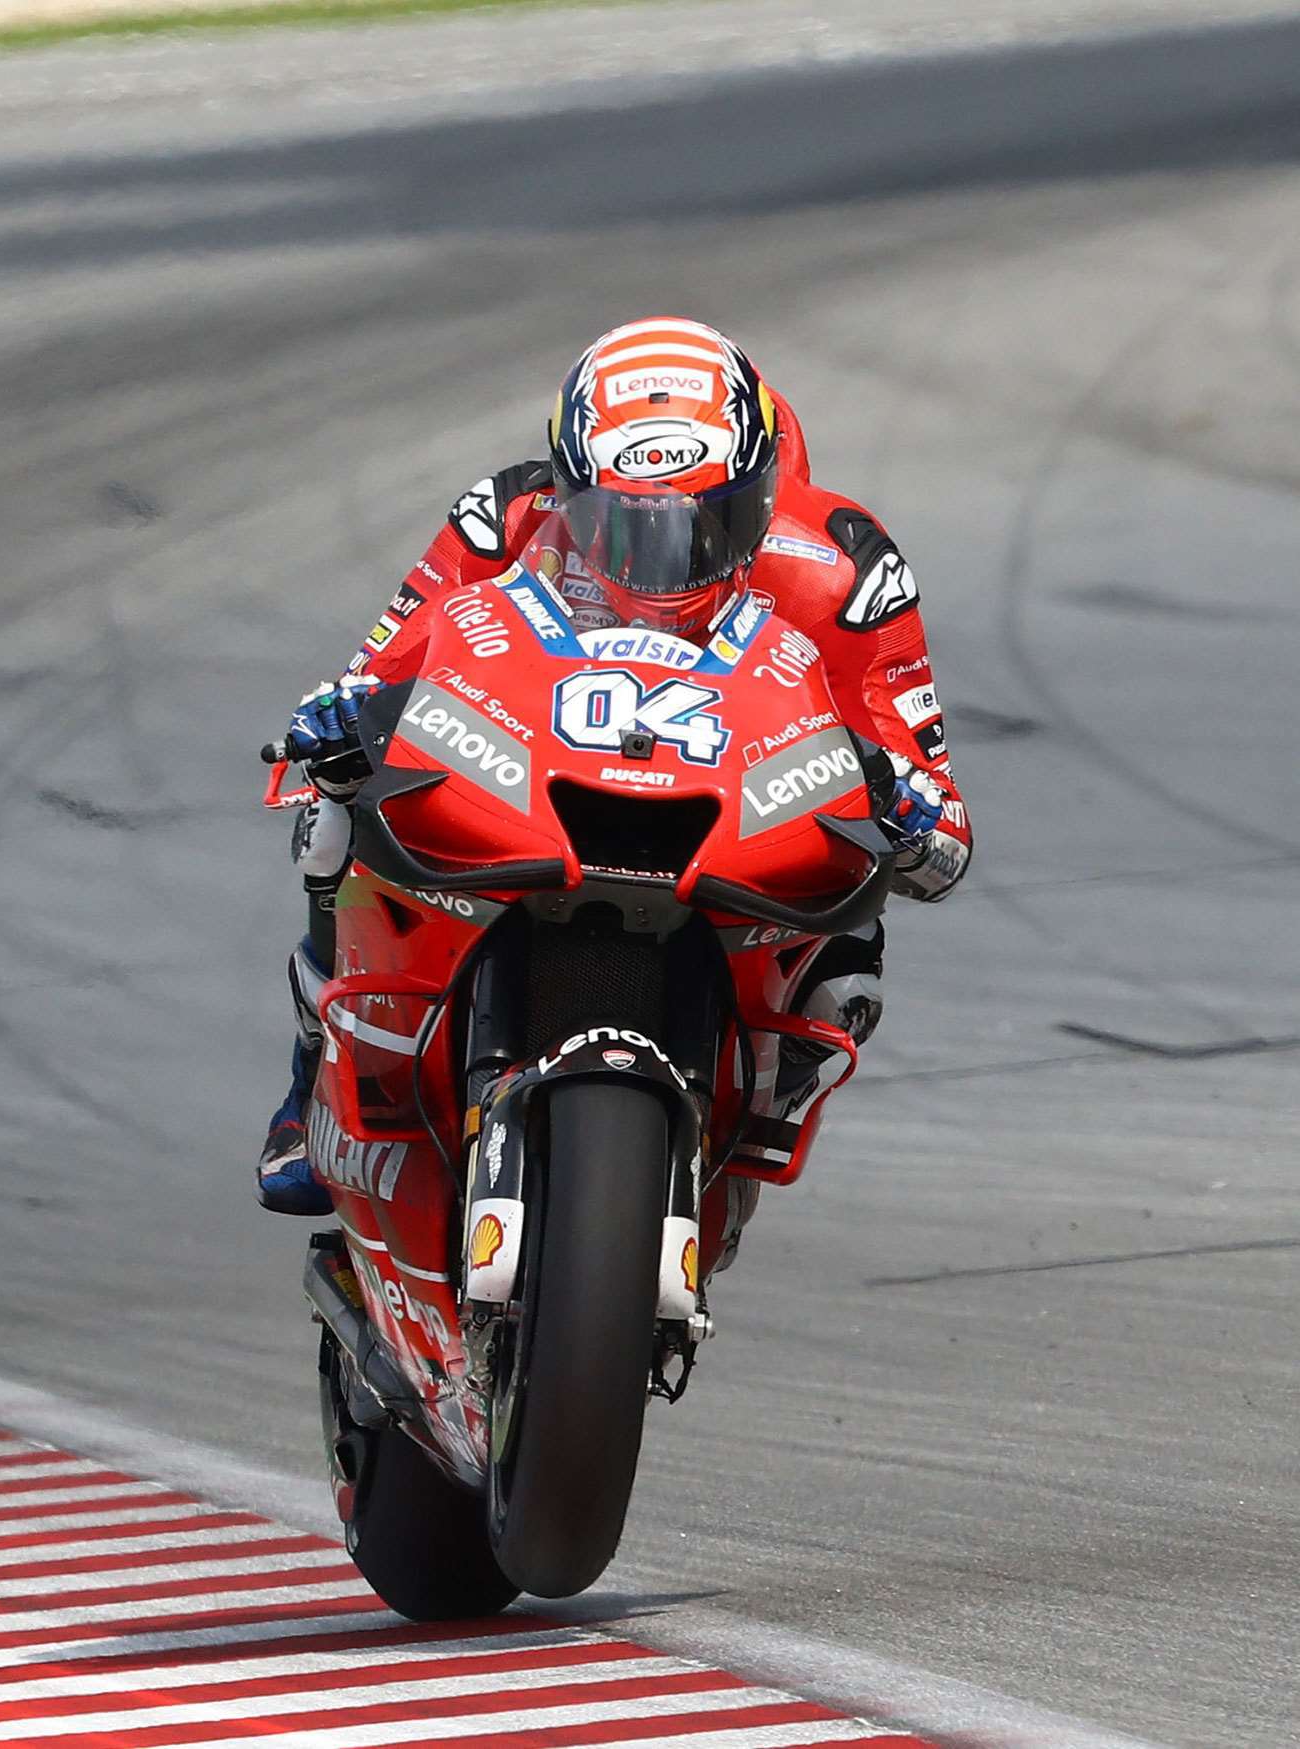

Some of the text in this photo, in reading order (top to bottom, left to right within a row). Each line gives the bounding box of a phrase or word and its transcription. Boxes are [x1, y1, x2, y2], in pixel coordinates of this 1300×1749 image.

[615, 375, 704, 396] Lenovo
[620, 448, 701, 466] SUOMY
[593, 634, 695, 667] valsir
[403, 694, 526, 787] Lenovo
[445, 674, 535, 742] Audi Sport
[550, 667, 734, 769] 04
[762, 711, 838, 751] Audi Sport
[600, 767, 676, 787] DUCATI
[742, 746, 860, 818] Lenovo
[537, 1026, 688, 1091] Lenovo
[307, 1098, 409, 1202] DUCATI
